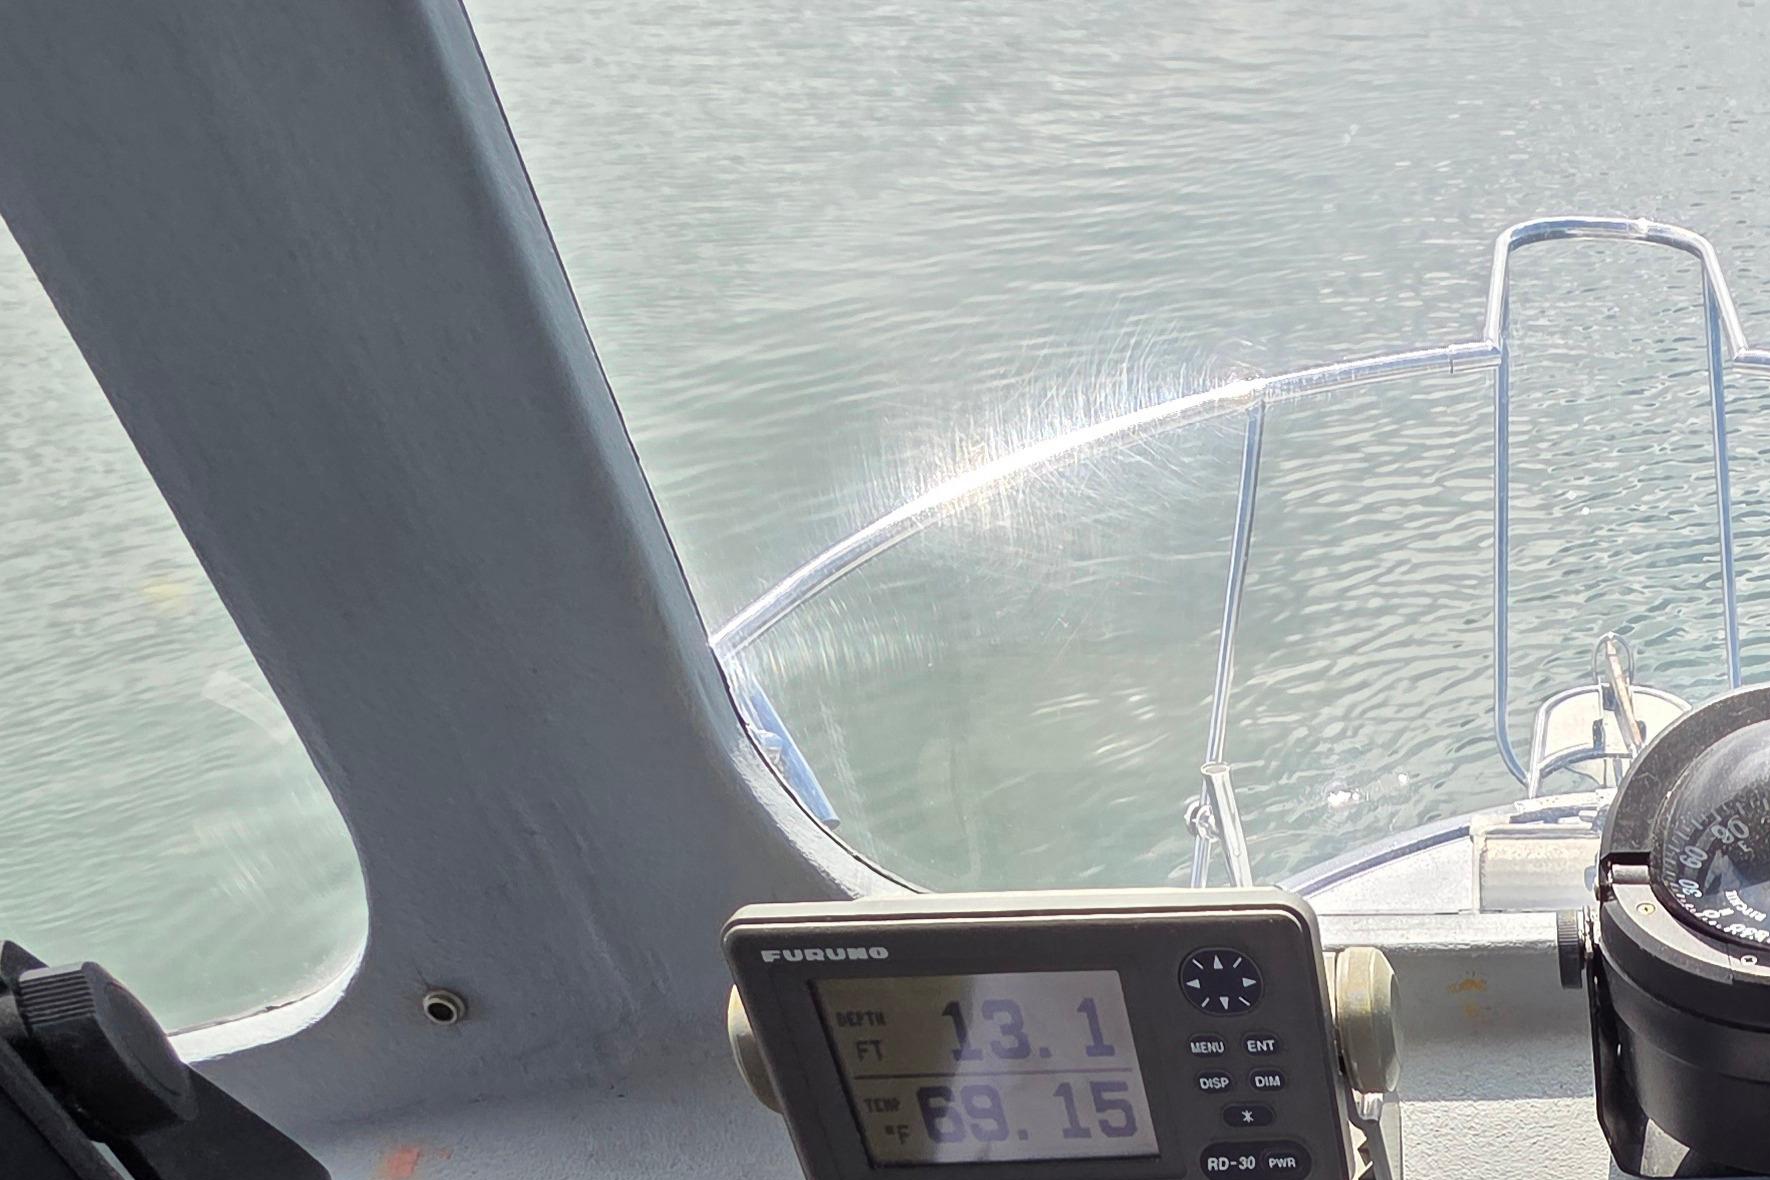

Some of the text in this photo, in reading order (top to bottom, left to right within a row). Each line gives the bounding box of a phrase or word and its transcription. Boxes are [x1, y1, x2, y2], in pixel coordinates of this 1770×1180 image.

[1711, 816, 1750, 845] 90
[1679, 844, 1708, 870] 60
[1678, 878, 1702, 899] 30
[761, 946, 890, 963] FURUNO
[836, 1011, 886, 1028] DEPTH
[941, 996, 1116, 1061] 13.1
[855, 1039, 885, 1063] FT
[1190, 1037, 1226, 1056] MENU
[1245, 1036, 1276, 1054] ENT
[1199, 1075, 1231, 1091] DISP
[1253, 1073, 1283, 1090] DIM
[1206, 1153, 1257, 1173] RD-30
[1267, 1154, 1297, 1171] PWR
